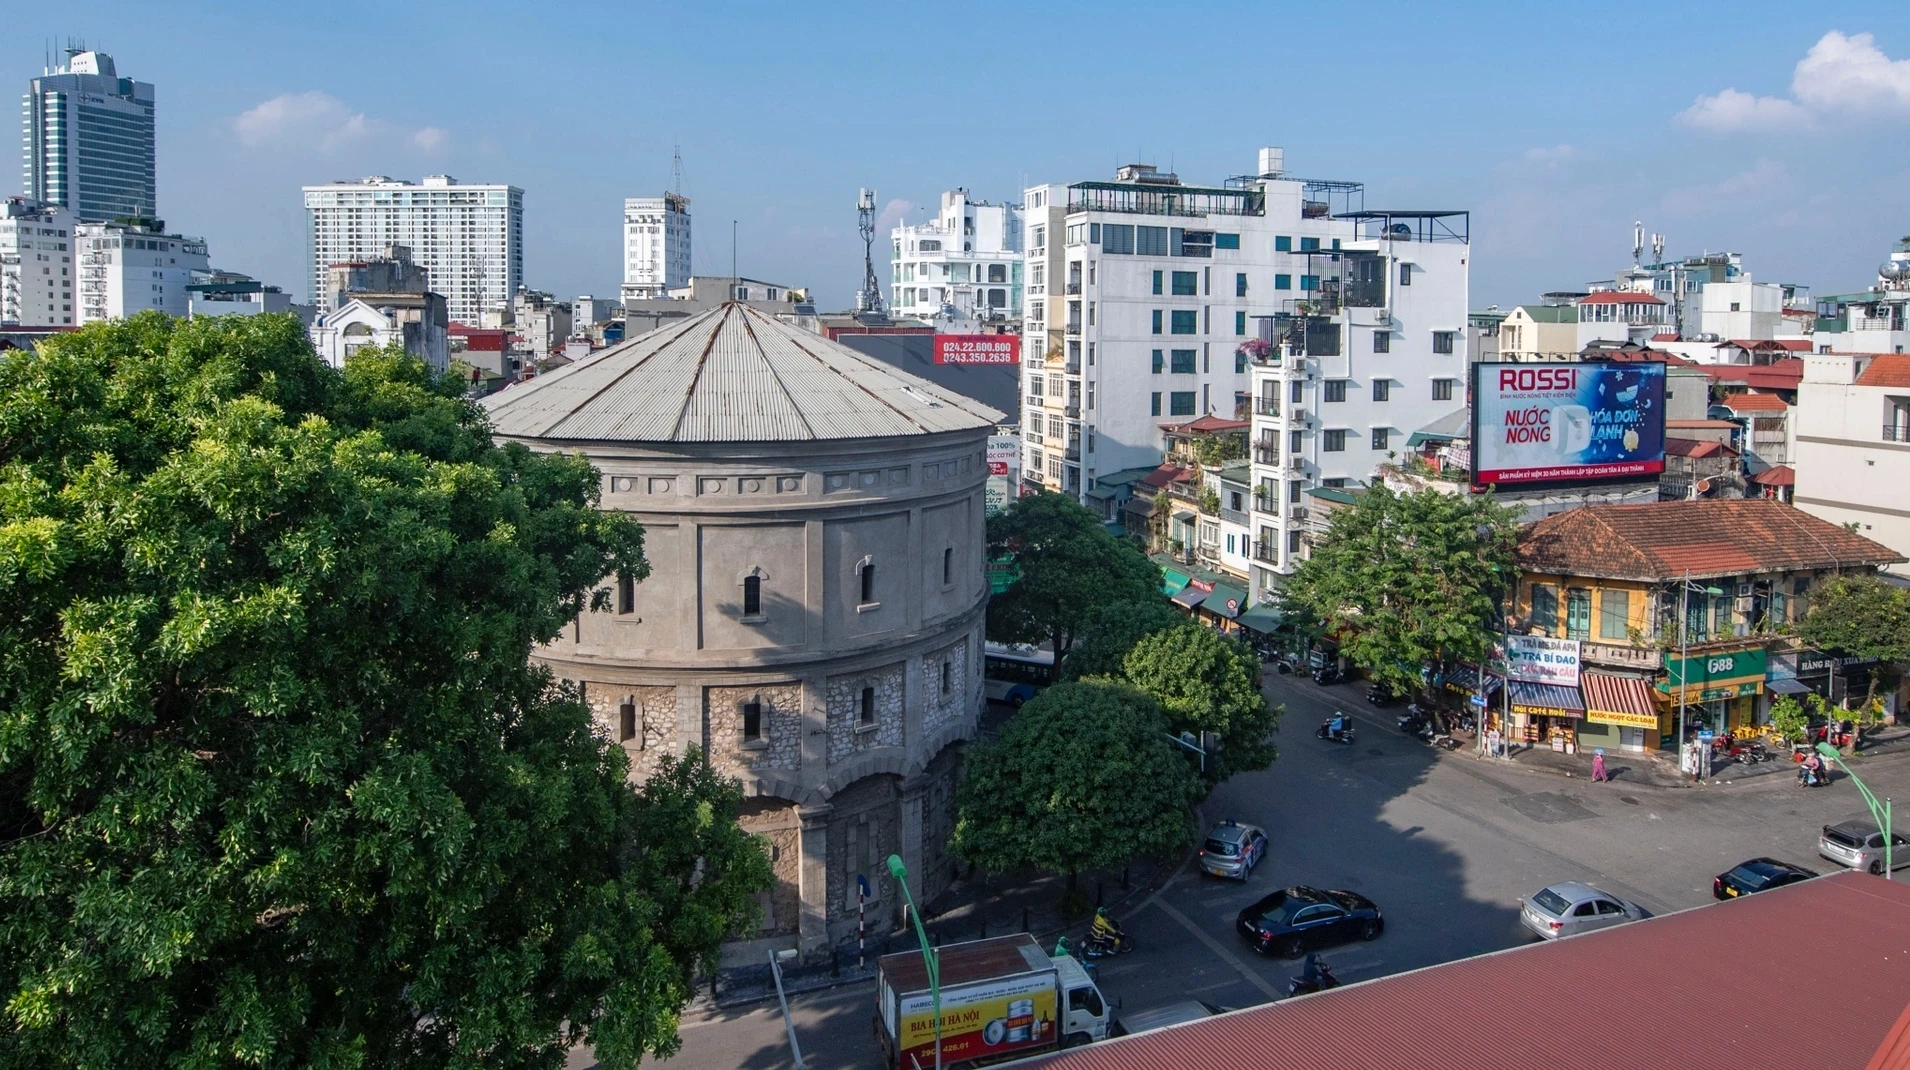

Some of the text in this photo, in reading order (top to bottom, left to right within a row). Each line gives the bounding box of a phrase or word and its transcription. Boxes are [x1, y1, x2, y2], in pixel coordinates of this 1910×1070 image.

[944, 342, 1011, 351] 024.22.600.600
[944, 353, 1011, 362] 0243.350.2636
[1500, 369, 1576, 391] ROSSI
[1505, 405, 1550, 426] NƯỚC
[1615, 409, 1639, 423] ĐƠN
[1506, 422, 1550, 443] NÓNG
[1522, 651, 1576, 664] TRÀ BÍ ĐAO
[1707, 657, 1733, 674] F88
[1802, 659, 1823, 670] HÀNG
[911, 1021, 926, 1032] BIA
[948, 1013, 961, 1025] HÀ
[963, 1010, 980, 1023] NỘI
